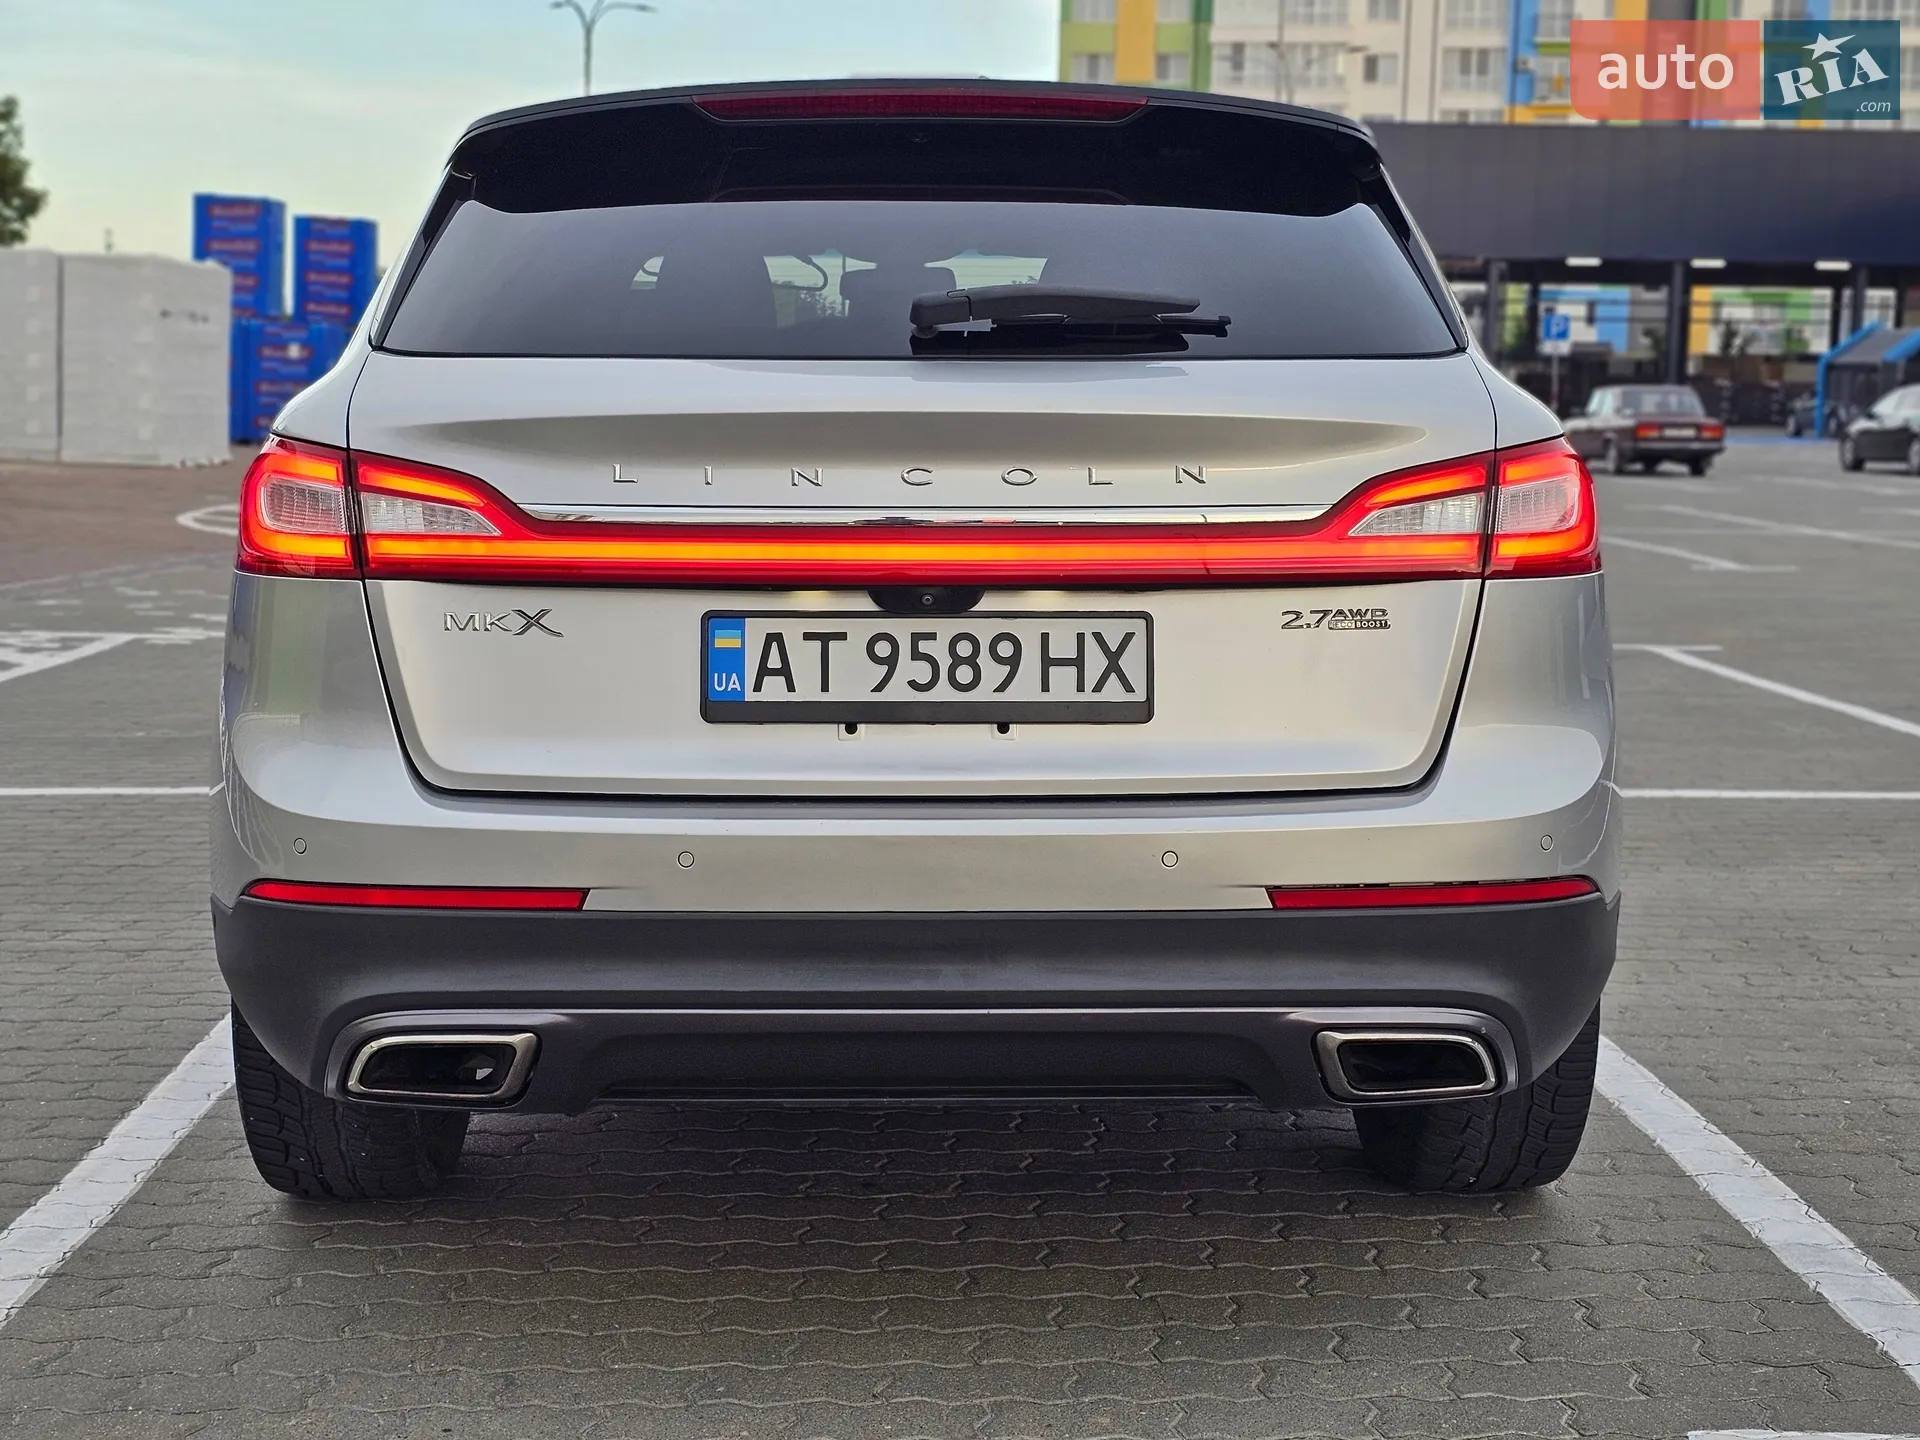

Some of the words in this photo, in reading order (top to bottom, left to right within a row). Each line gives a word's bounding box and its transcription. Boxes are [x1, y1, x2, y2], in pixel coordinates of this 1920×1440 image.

[612, 463, 1208, 487] LINCOLN
[444, 608, 564, 638] MKX
[1281, 609, 1333, 629] 2.7
[752, 632, 847, 693] AT
[865, 632, 1023, 693] 9589
[1040, 632, 1136, 693] HX
[714, 672, 741, 692] UA
